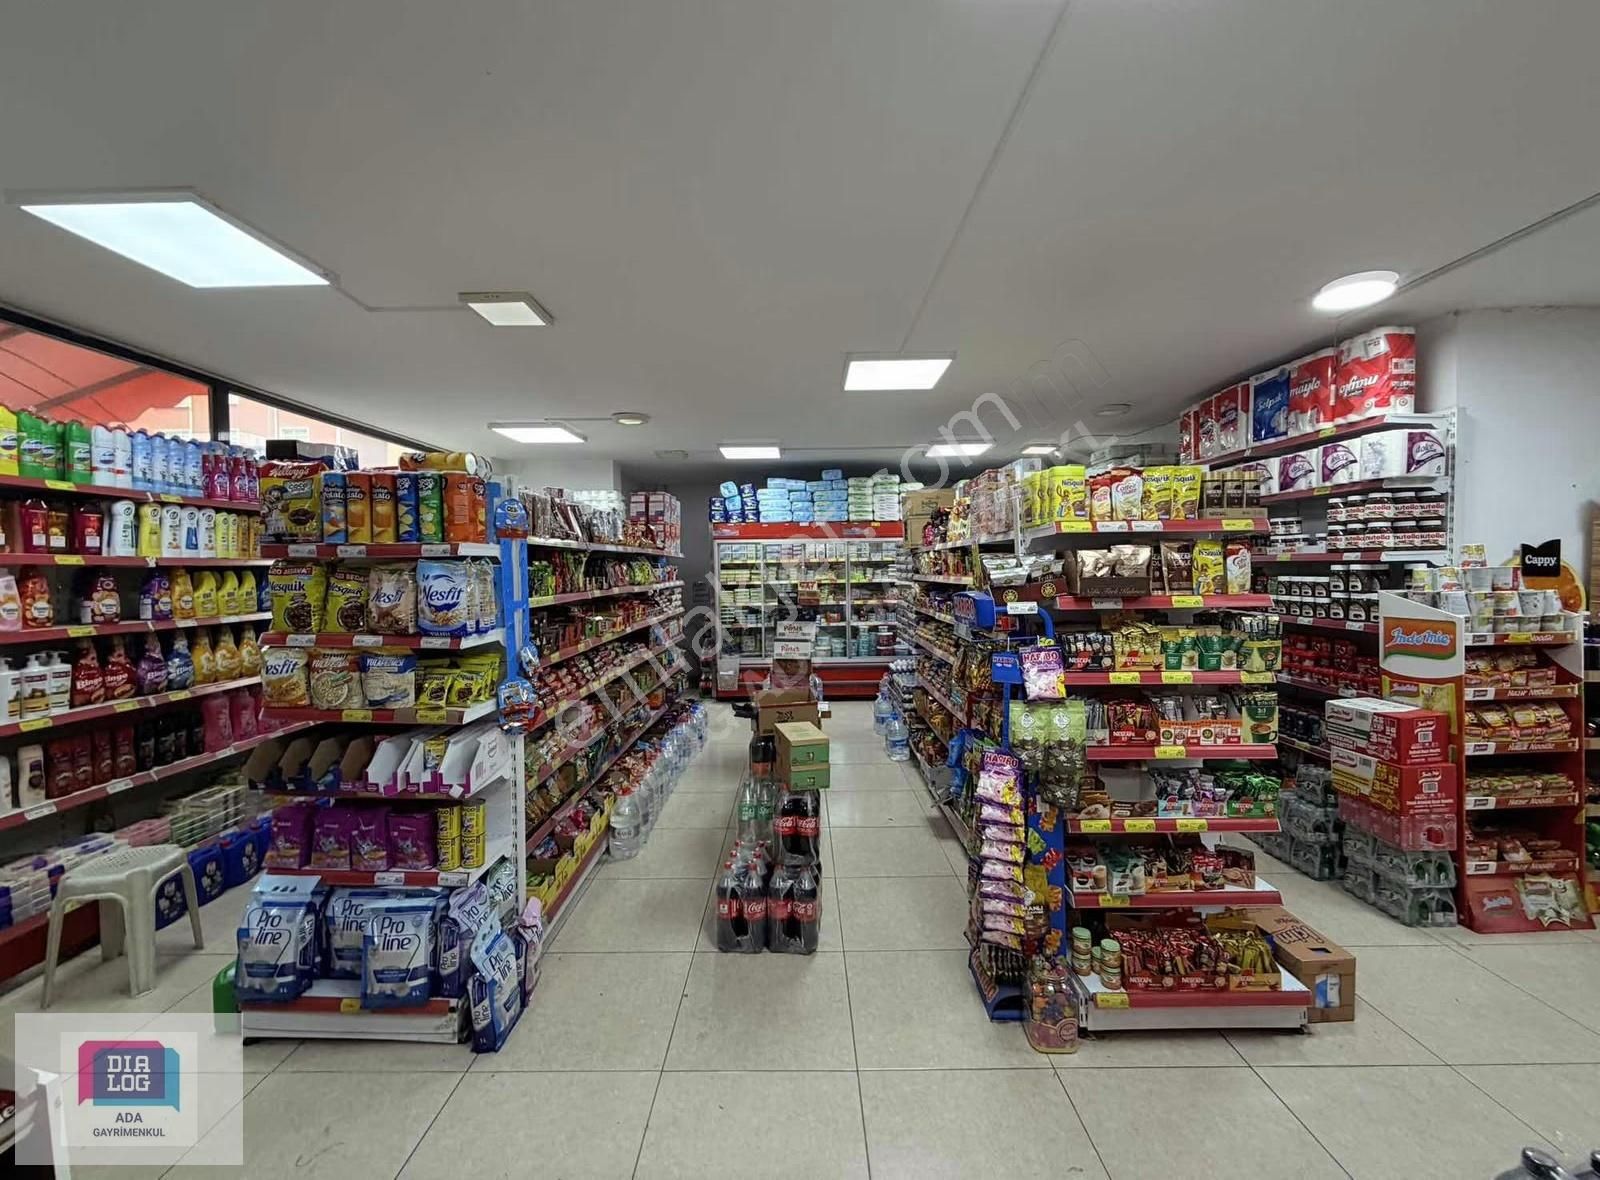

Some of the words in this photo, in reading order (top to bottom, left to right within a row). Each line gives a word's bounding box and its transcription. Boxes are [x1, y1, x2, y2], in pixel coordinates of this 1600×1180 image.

[1525, 555, 1557, 566] Cappy
[421, 582, 465, 602] Nesfit
[1022, 653, 1059, 663] HARIBO
[256, 910, 282, 928] Pro
[380, 916, 405, 934] Pro
[255, 927, 282, 945] line
[382, 934, 411, 951] line
